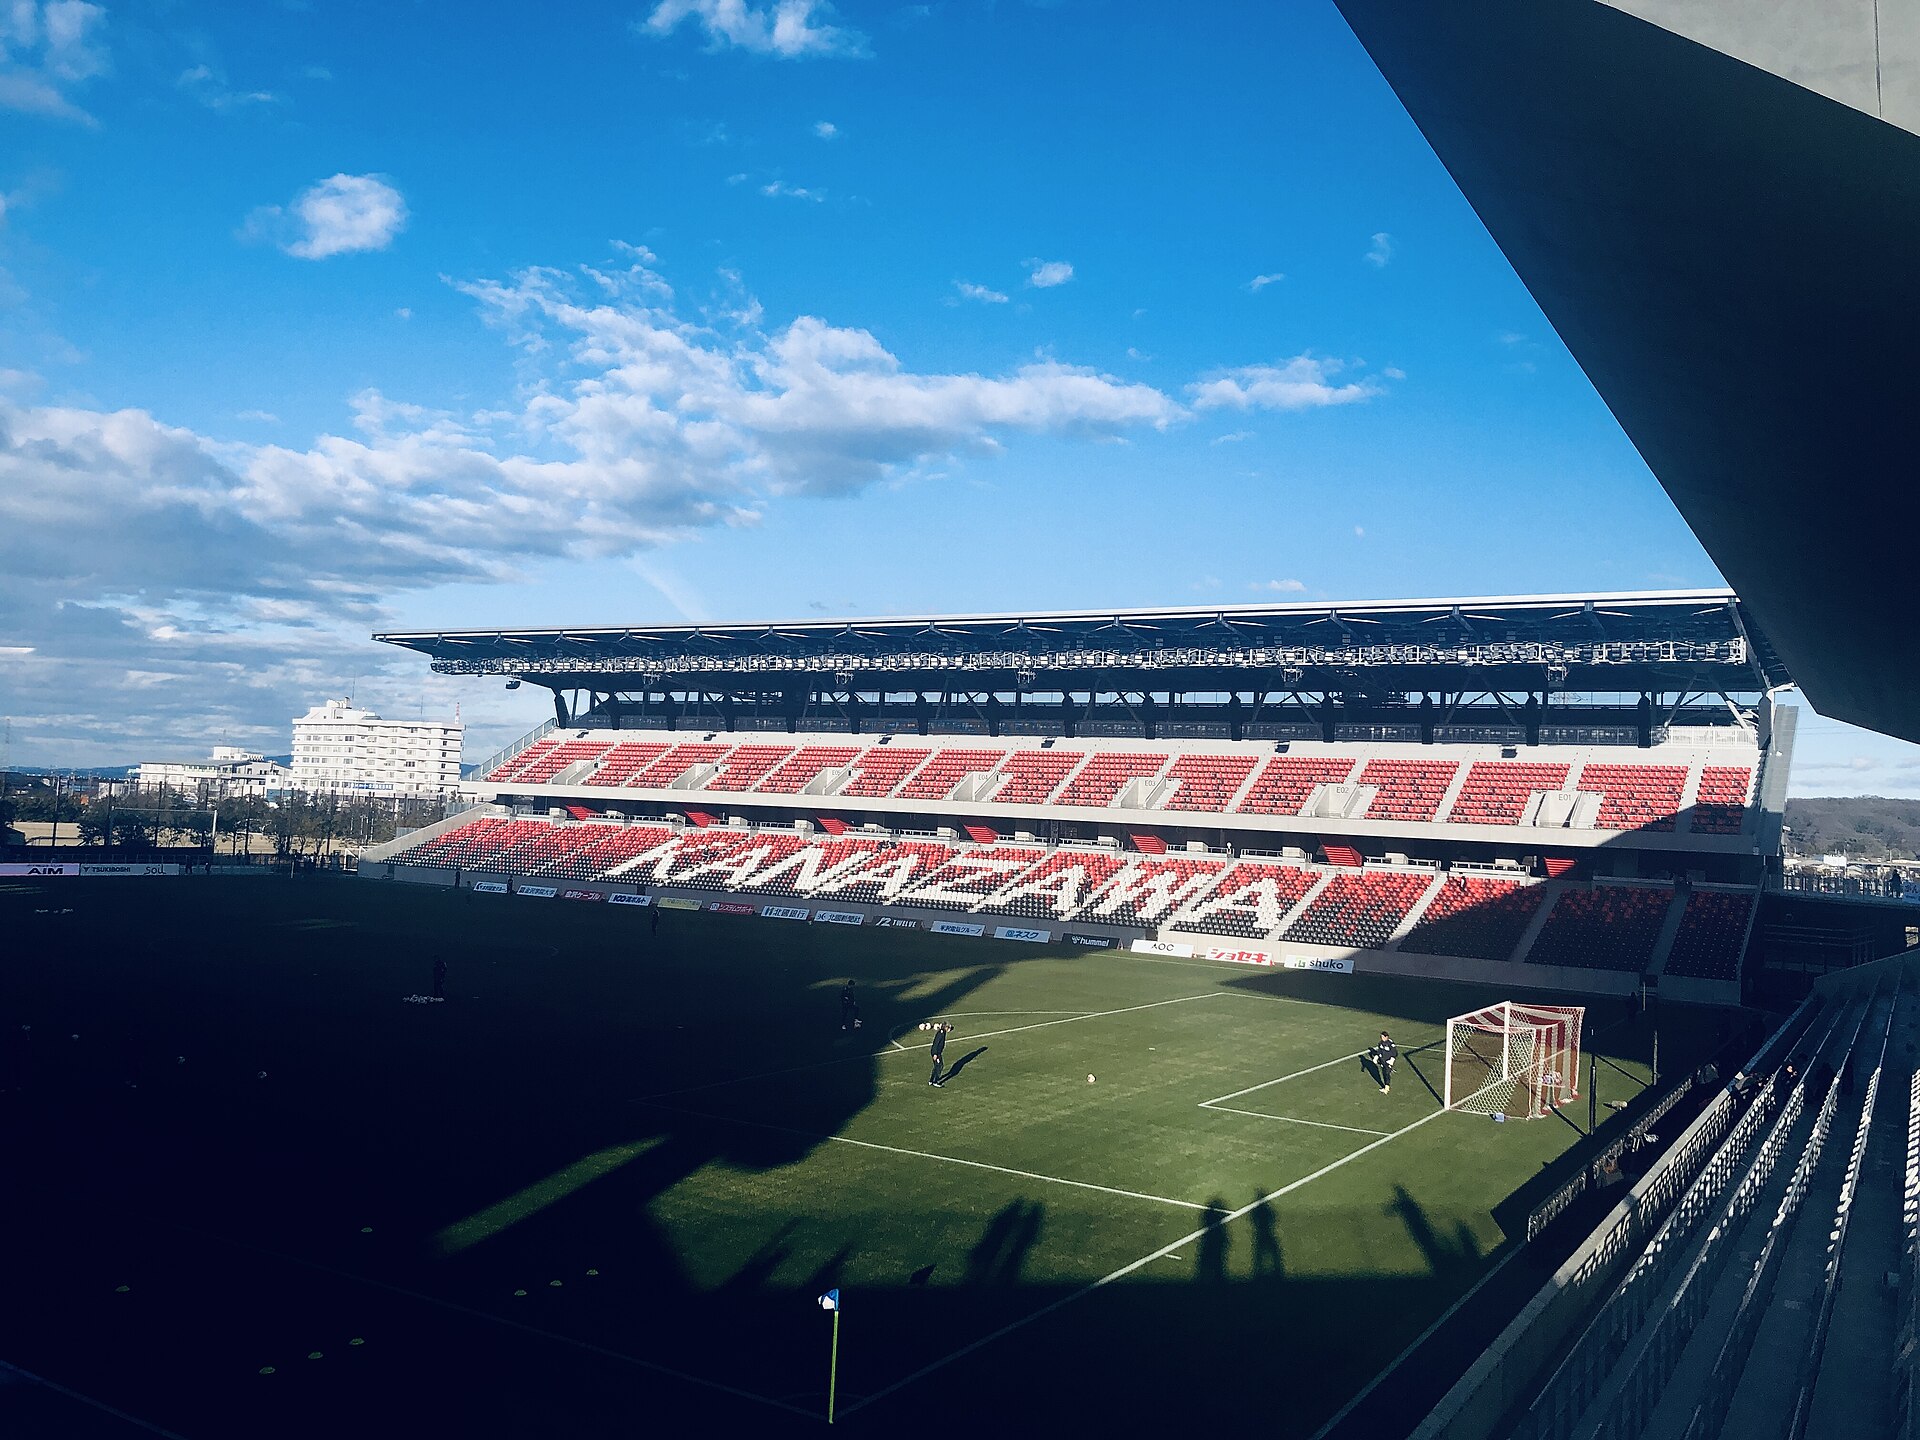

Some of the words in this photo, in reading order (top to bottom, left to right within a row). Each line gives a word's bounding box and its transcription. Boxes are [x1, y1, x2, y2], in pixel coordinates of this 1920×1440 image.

[1558, 793, 1571, 801] E01
[28, 867, 64, 875] AIM
[604, 836, 1281, 930] KANAZAWA
[564, 890, 601, 900] 金沢ケーブル
[773, 908, 807, 918] 北國銀行
[892, 919, 917, 928] TWELVE
[1080, 937, 1110, 947] hummel
[1210, 948, 1268, 963] ショセキ
[1309, 957, 1344, 970] shuko
